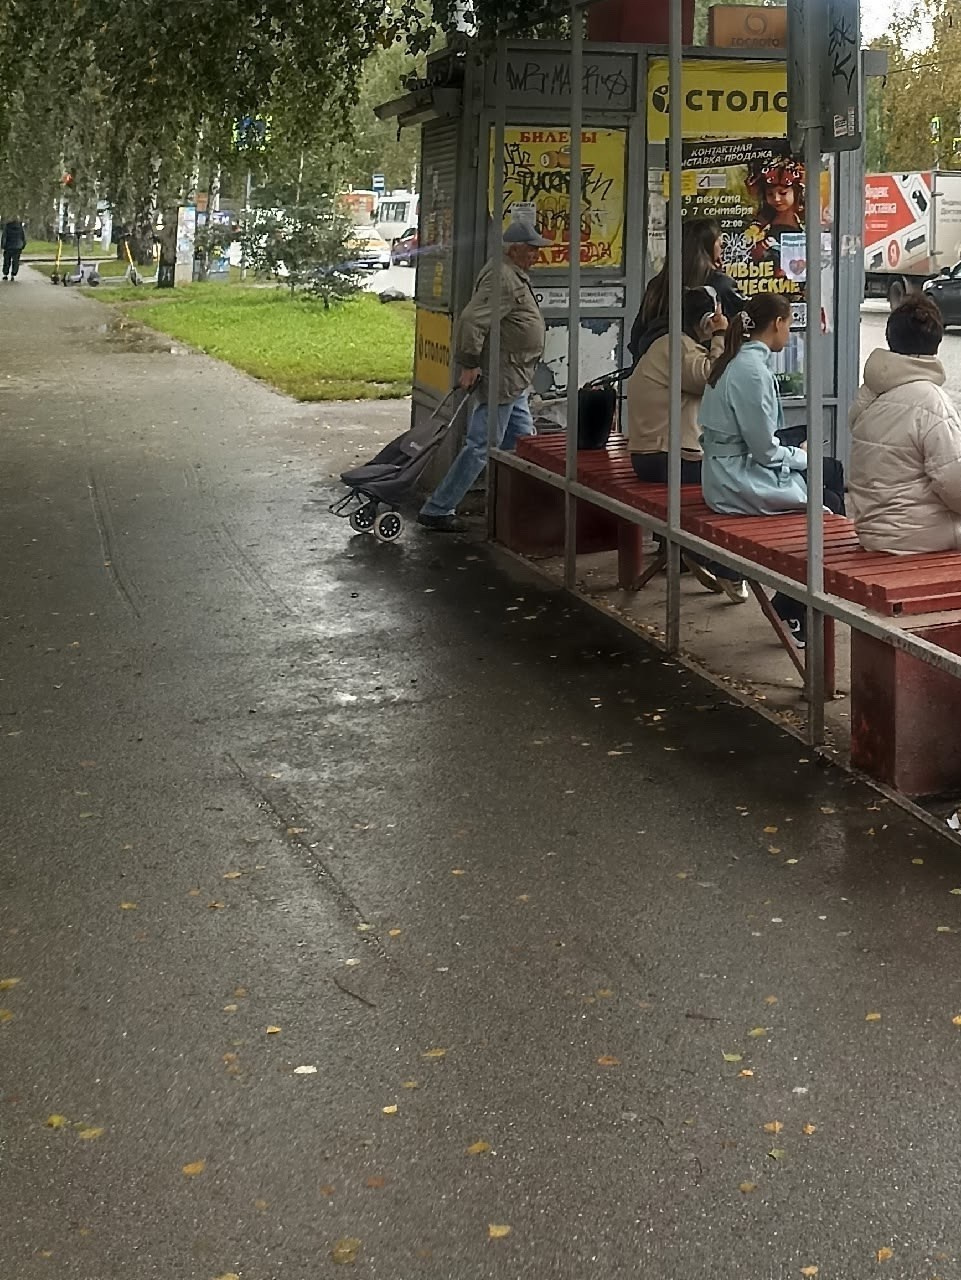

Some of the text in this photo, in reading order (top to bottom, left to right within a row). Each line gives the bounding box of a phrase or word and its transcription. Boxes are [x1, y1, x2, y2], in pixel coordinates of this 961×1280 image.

[685, 89, 788, 113] СТОЛО
[520, 131, 597, 143] БИЛЕЫ
[691, 143, 753, 157] КОНТАКТНАЯ
[681, 150, 773, 167] ЫСТАВКА-ПРОДАЖА
[696, 194, 741, 205] августа
[703, 205, 754, 220] сентября
[724, 261, 775, 279] ИВЫЕ
[736, 278, 801, 296] ЧЕСКИЕ
